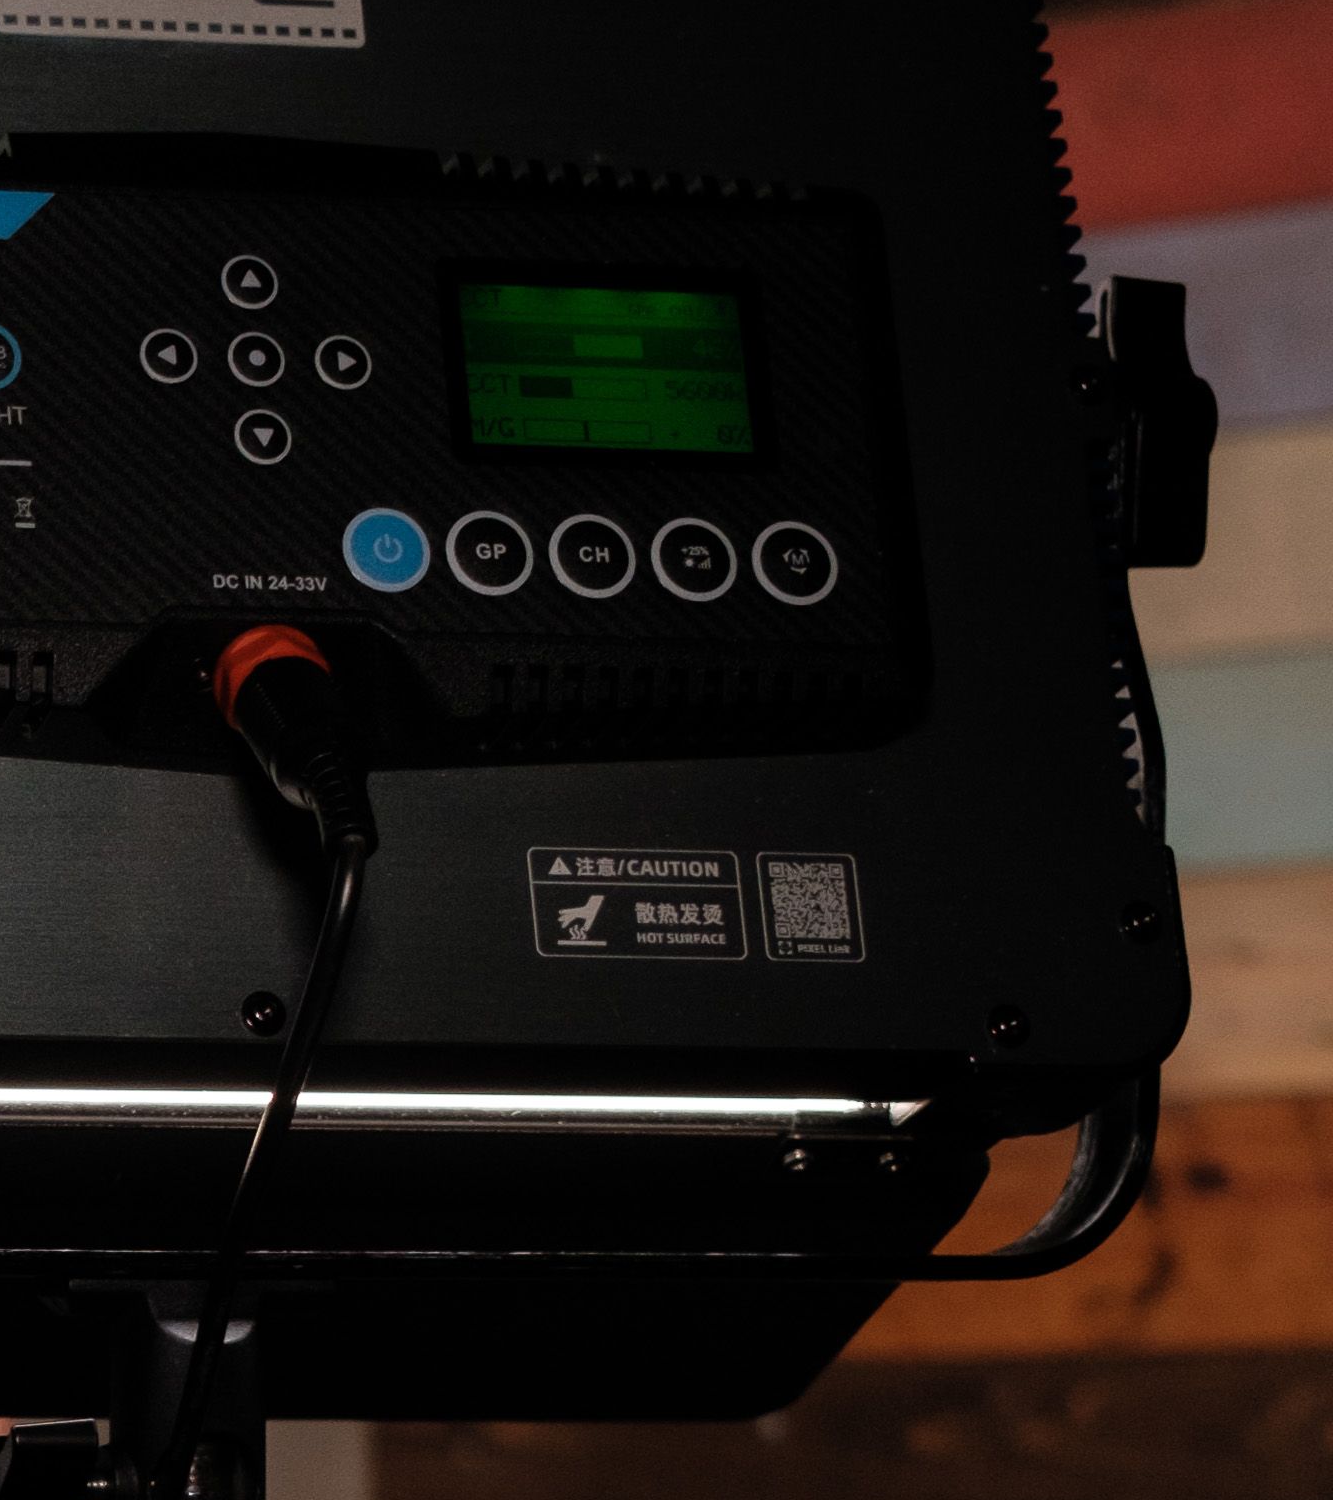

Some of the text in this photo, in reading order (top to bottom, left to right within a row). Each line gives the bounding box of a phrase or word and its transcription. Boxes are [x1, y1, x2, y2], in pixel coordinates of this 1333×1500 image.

[475, 543, 507, 561] GP
[579, 546, 610, 564] CH
[212, 573, 327, 592] DC IN 24-33V
[636, 932, 727, 946] HOT SURFACE
